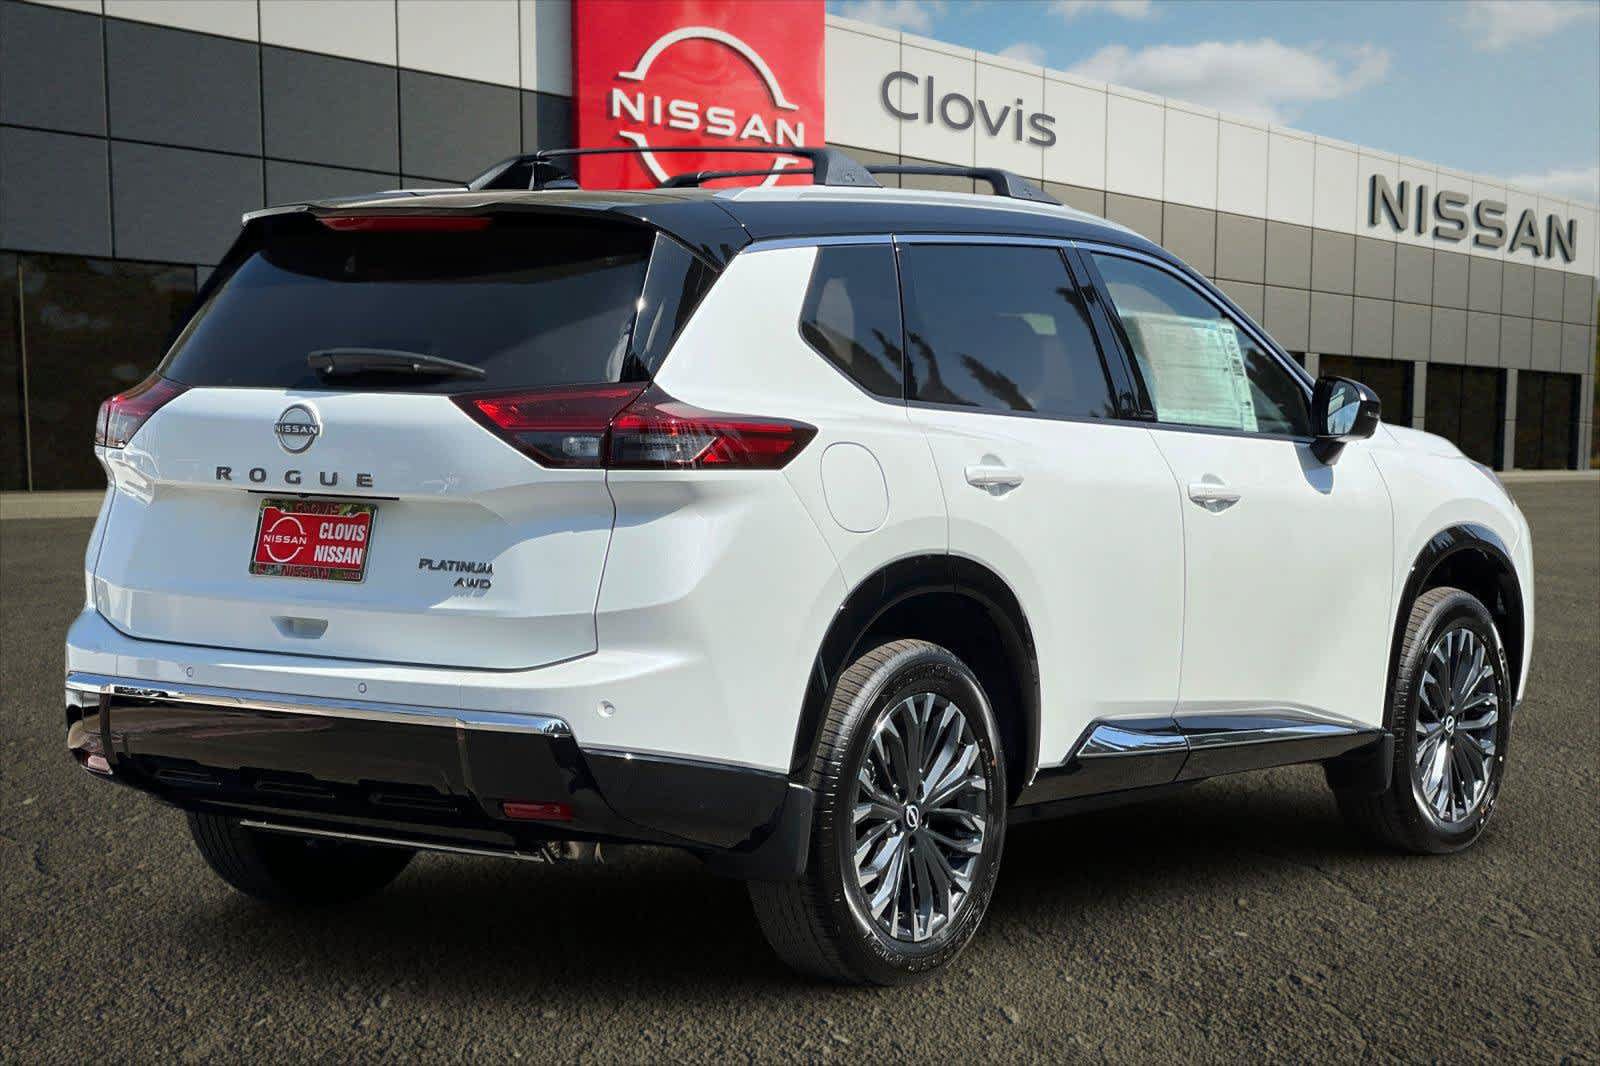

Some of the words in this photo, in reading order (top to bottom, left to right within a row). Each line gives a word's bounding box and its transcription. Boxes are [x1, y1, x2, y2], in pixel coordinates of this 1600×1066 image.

[612, 88, 805, 147] NISSAN
[882, 71, 1057, 147] Clovis
[1368, 174, 1578, 263] NISSAN
[275, 423, 318, 435] NISSAN
[215, 466, 374, 488] ROGUE
[264, 534, 307, 545] NISSAN
[319, 522, 366, 541] CLOVIS
[314, 545, 363, 564] NISSAN
[418, 558, 493, 574] PLATINUM
[454, 577, 492, 589] AWD
